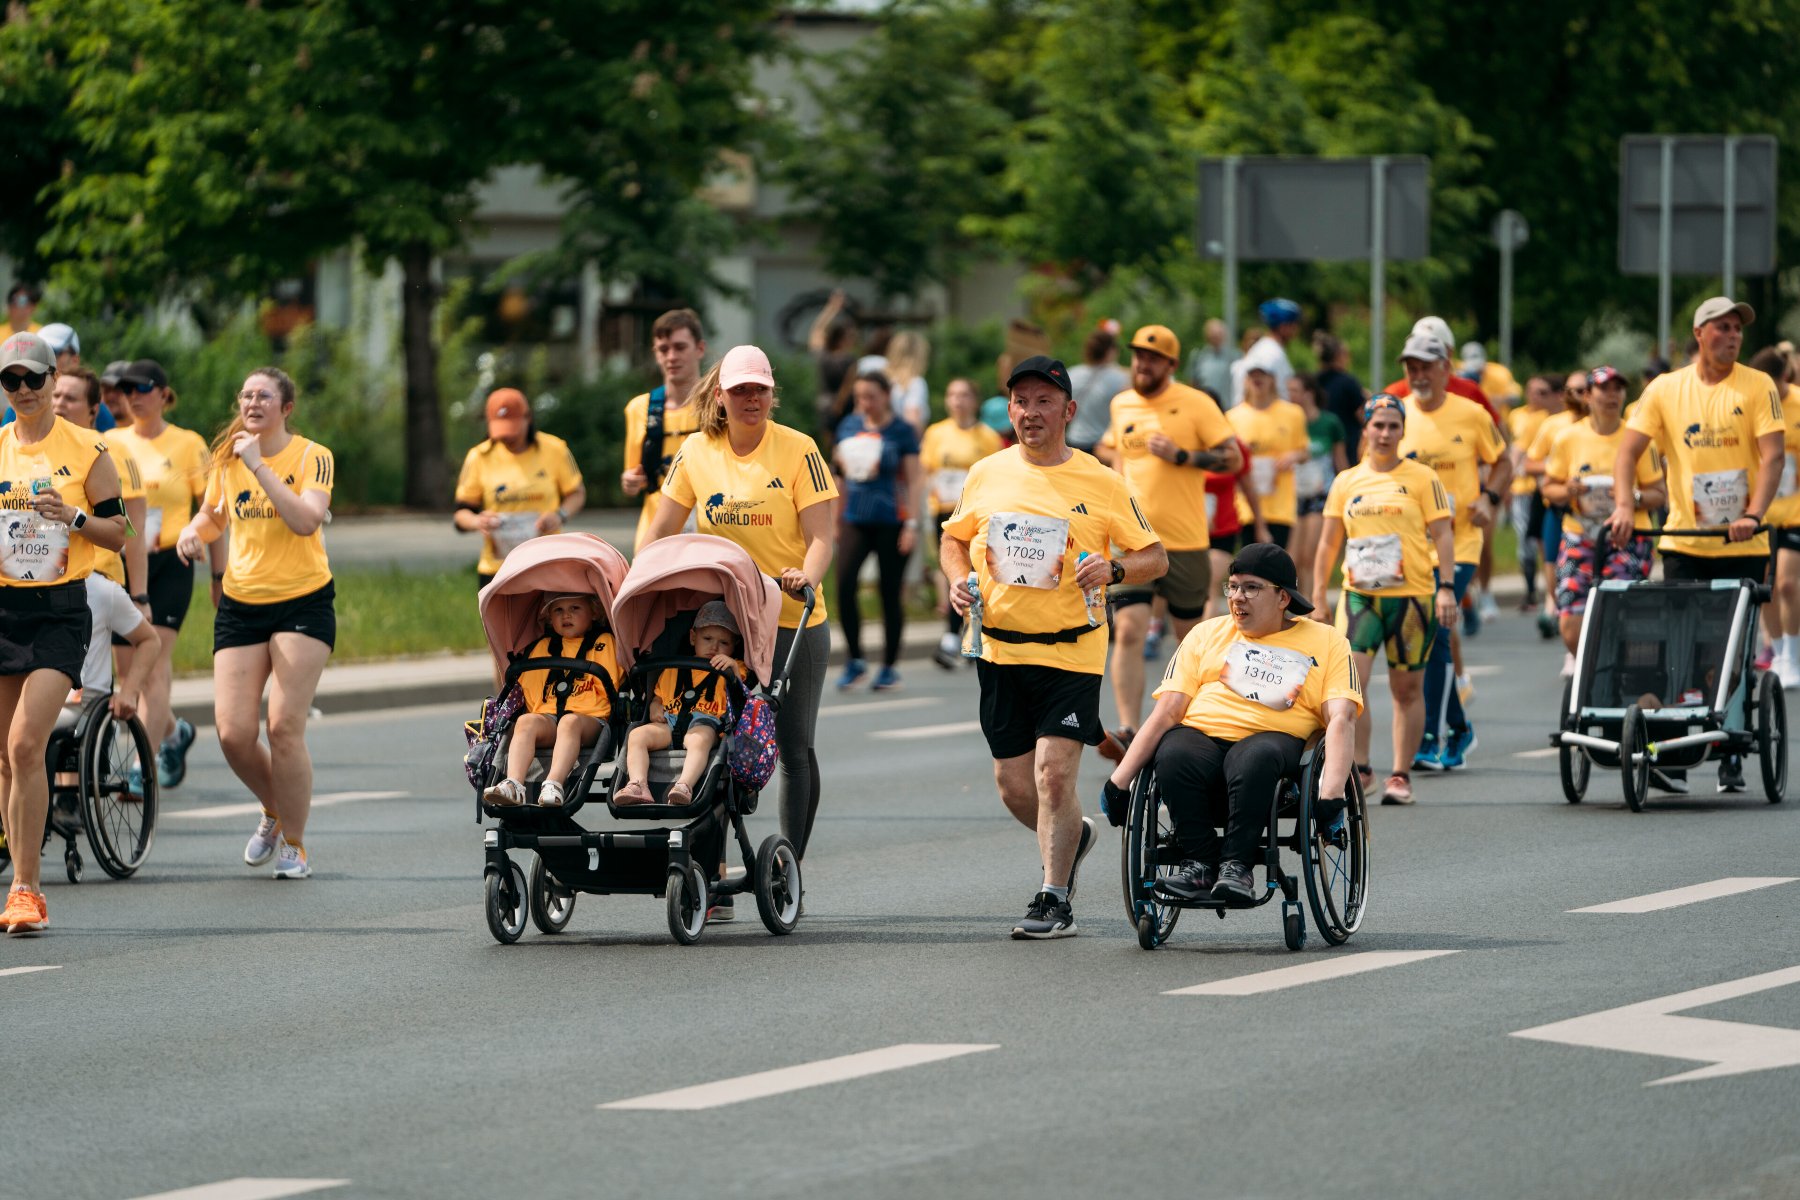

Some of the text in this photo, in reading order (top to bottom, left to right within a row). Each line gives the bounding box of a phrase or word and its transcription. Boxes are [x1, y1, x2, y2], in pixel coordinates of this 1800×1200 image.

[12, 543, 49, 556] 11095
[1006, 545, 1045, 561] 17029
[1052, 573, 1060, 583] 4
[1244, 665, 1283, 685] 13103
